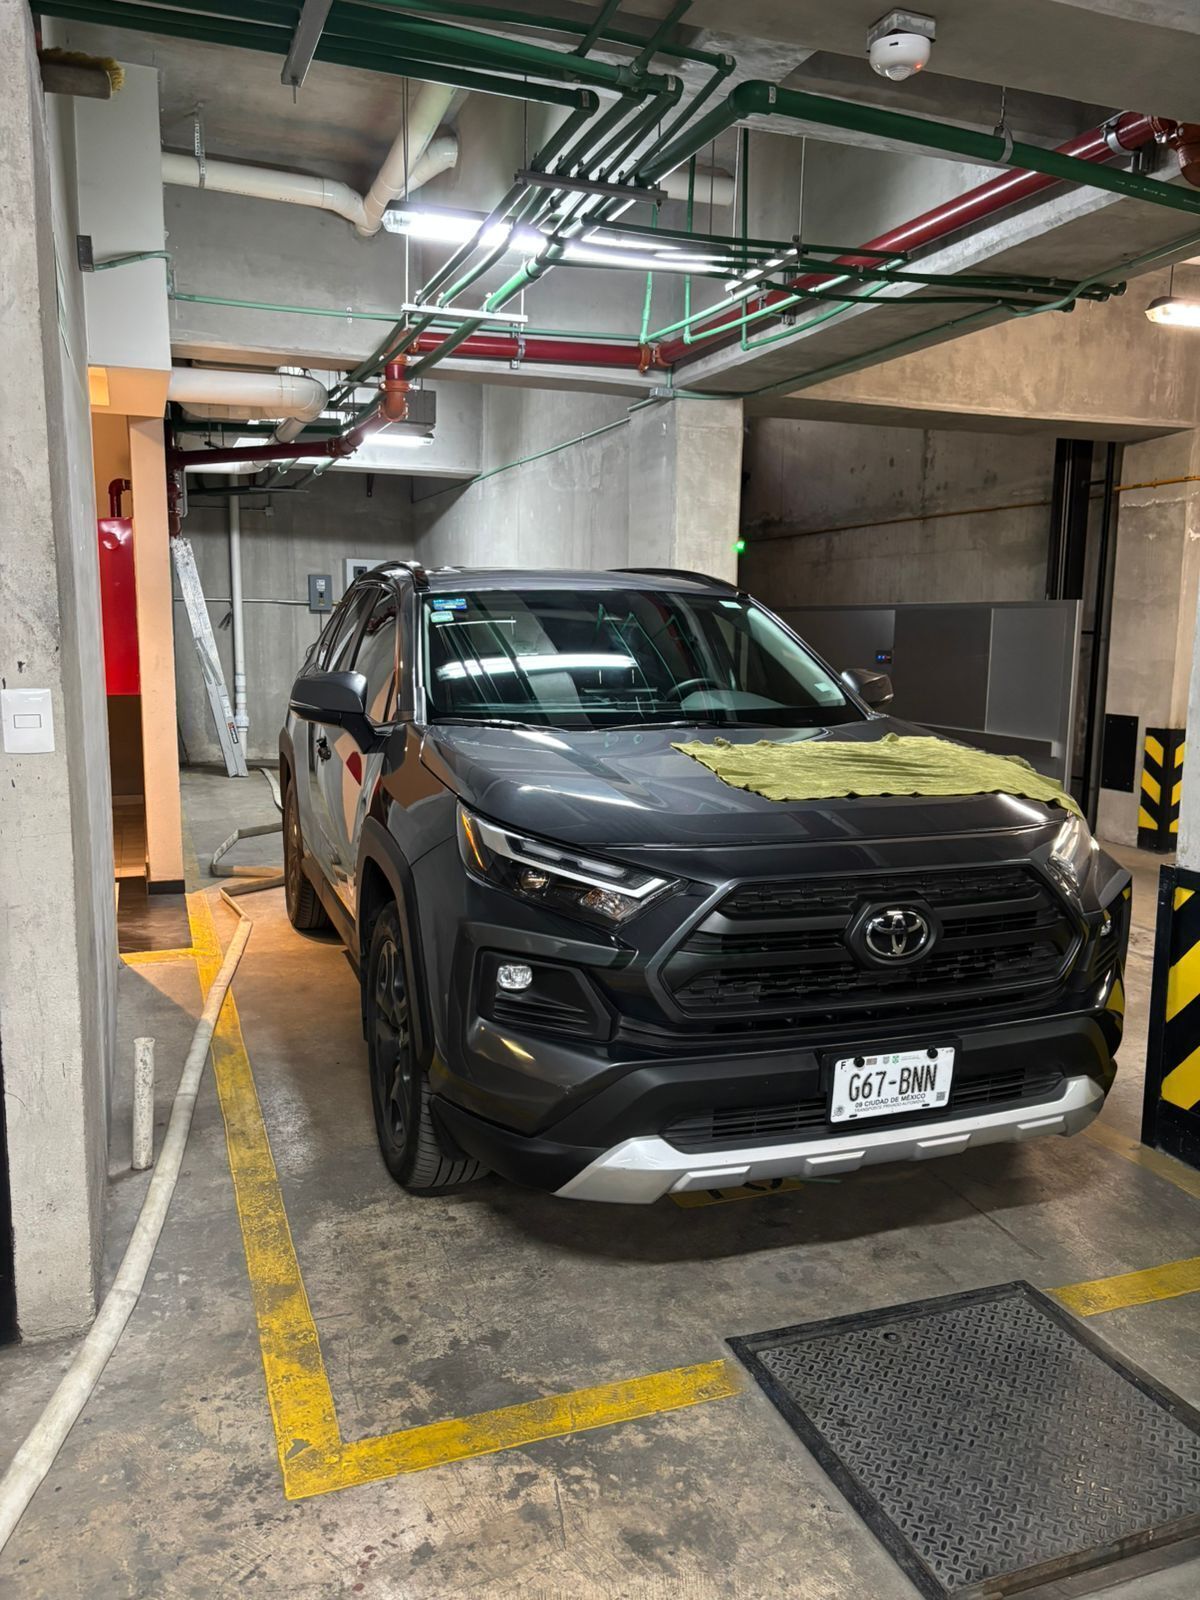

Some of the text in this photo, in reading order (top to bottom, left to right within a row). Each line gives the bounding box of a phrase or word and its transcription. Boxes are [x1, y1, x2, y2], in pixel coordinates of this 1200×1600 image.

[840, 1061, 847, 1070] F
[849, 1064, 938, 1102] G67-BNN
[864, 1098, 889, 1107] CIUDAD
[901, 1092, 926, 1101] MÉXICO
